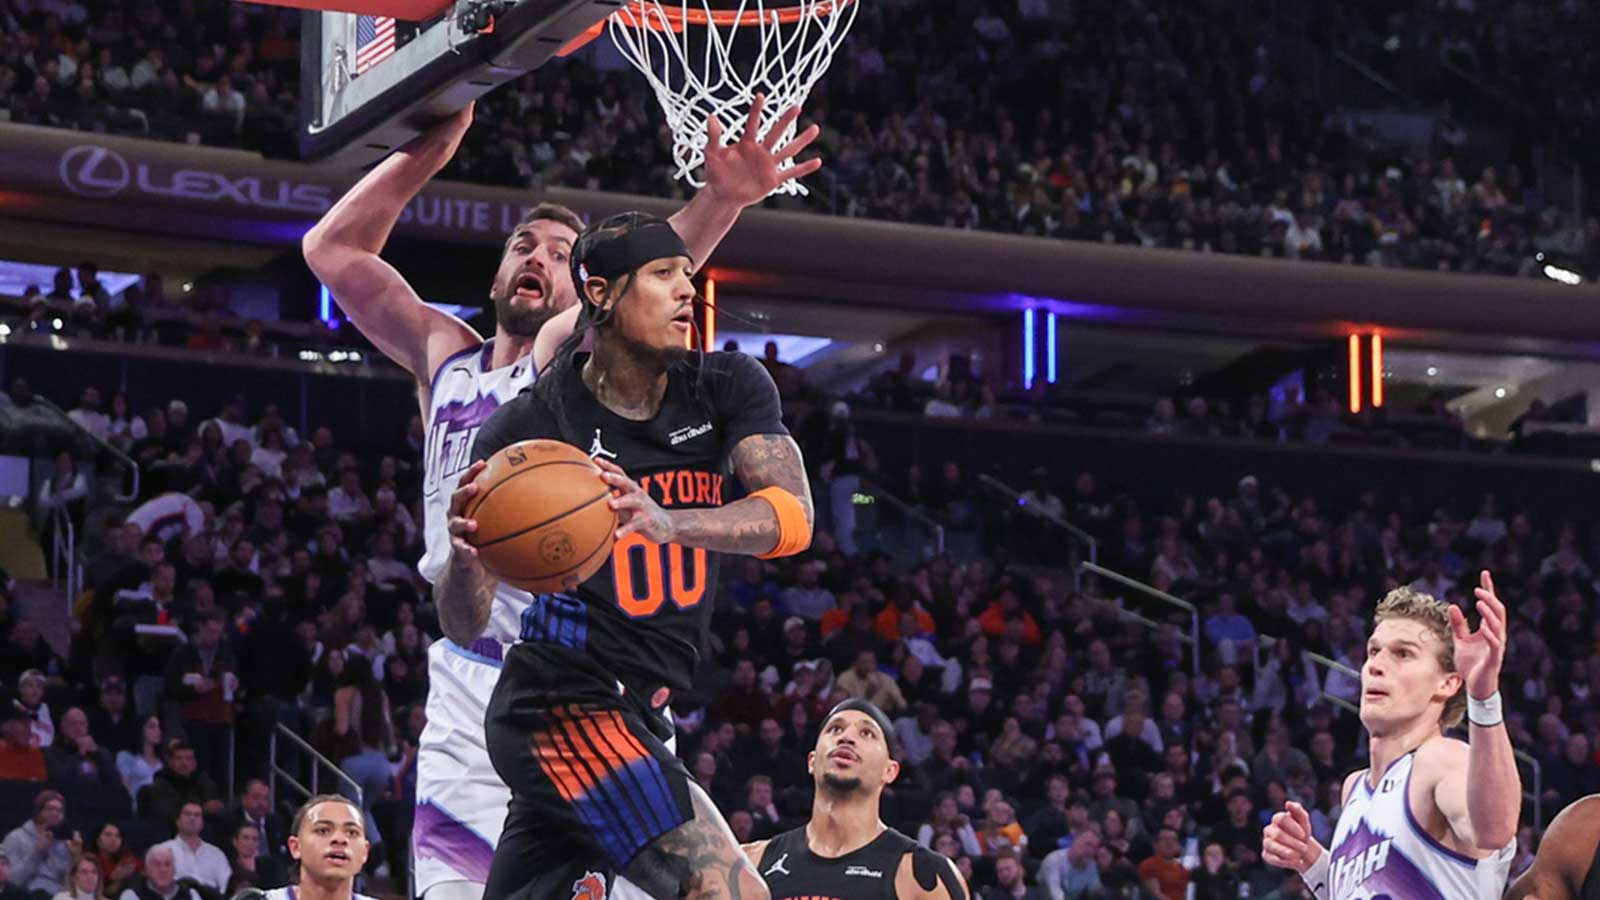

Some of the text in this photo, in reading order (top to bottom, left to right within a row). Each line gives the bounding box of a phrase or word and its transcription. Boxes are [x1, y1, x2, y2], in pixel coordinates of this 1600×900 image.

[136, 164, 333, 213] LEXUS
[655, 470, 723, 506] YORK
[612, 532, 707, 618] 00
[1328, 837, 1392, 900] UTAH
